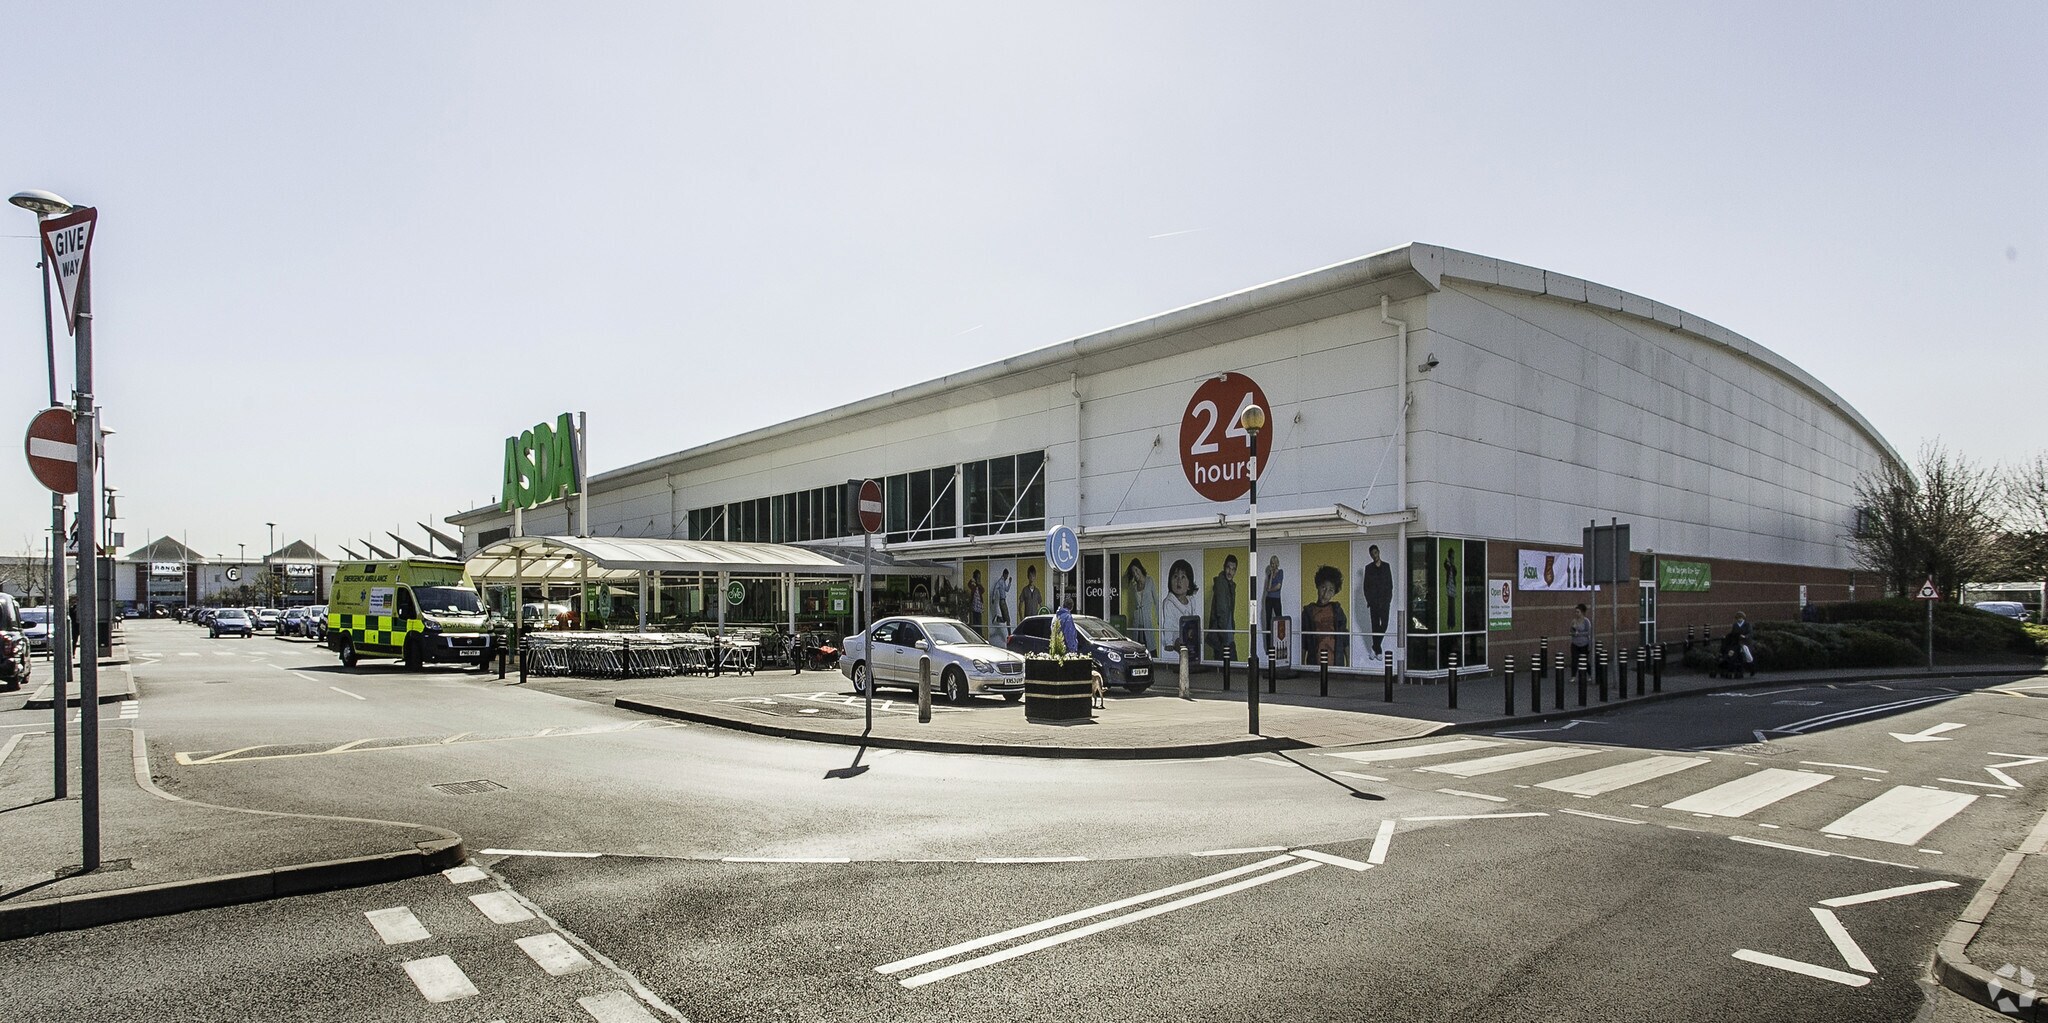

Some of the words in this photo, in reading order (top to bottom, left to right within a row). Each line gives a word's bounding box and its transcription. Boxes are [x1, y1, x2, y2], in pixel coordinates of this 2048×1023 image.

[55, 226, 84, 257] GIVE
[62, 258, 80, 278] WAY
[1190, 391, 1254, 456] 24
[501, 411, 582, 513] ASDA
[364, 574, 388, 583] AMBULANCE
[1523, 566, 1539, 580] ASDA
